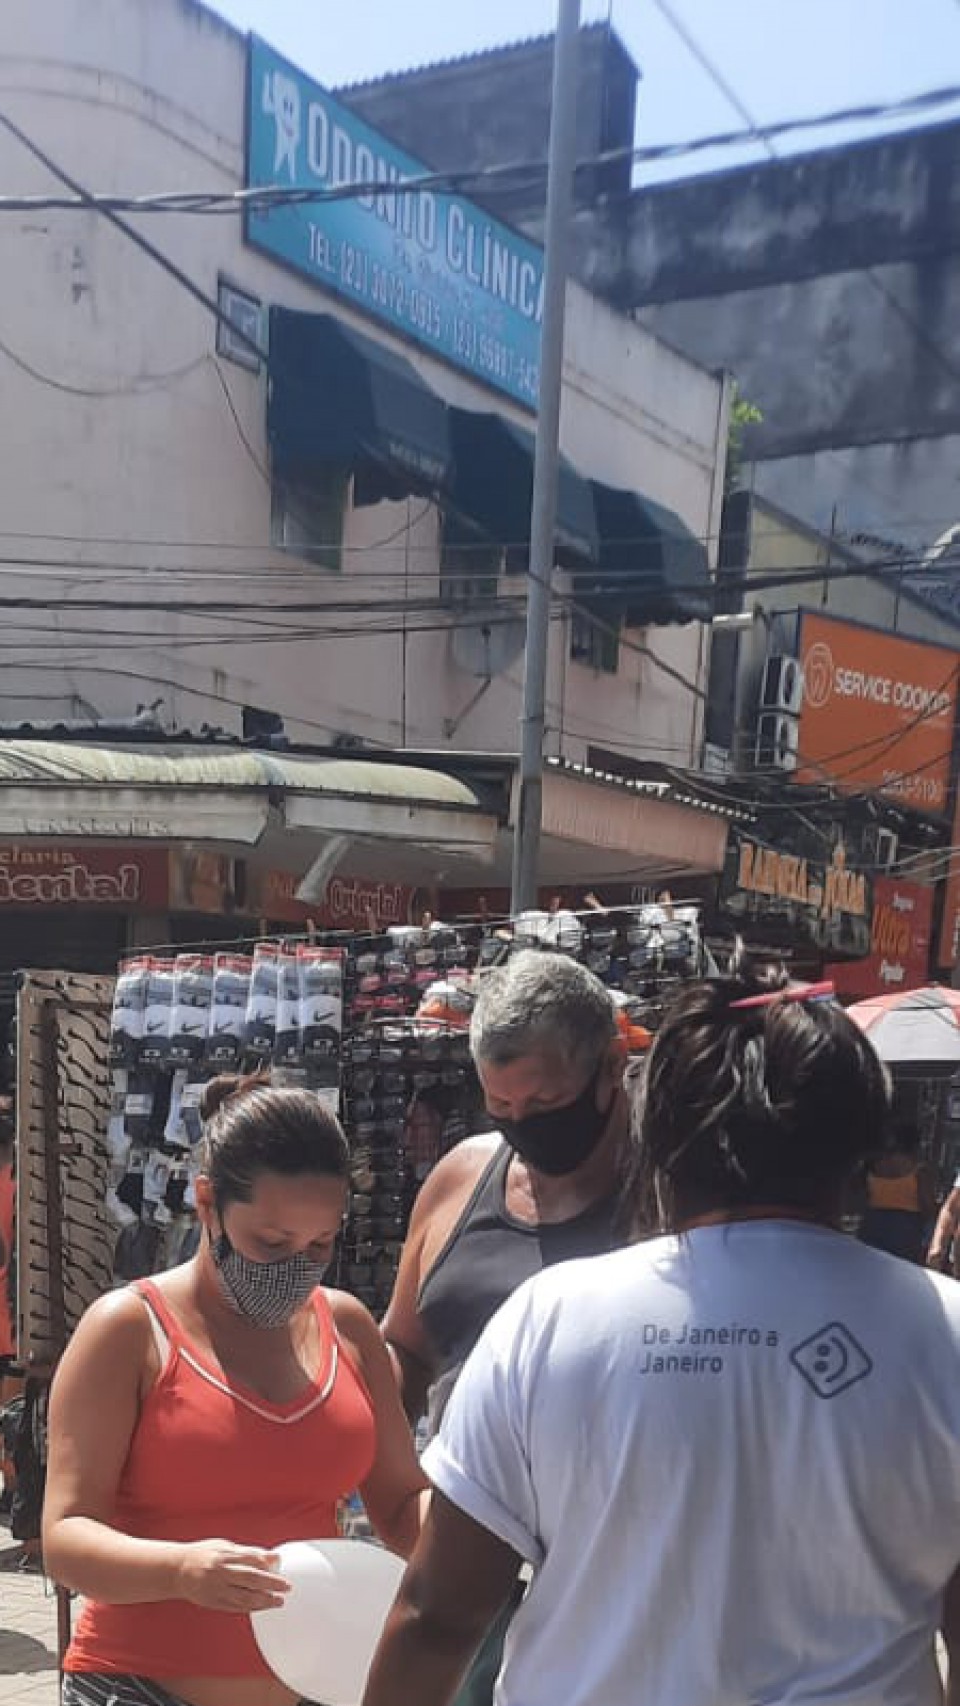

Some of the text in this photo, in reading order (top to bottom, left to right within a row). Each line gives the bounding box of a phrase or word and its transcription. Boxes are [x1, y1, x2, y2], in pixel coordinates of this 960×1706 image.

[307, 101, 437, 250] ODONTO
[834, 666, 892, 704] SERVICE
[643, 1321, 779, 1347] De Janeiro a
[639, 1351, 724, 1375] Janeiro
